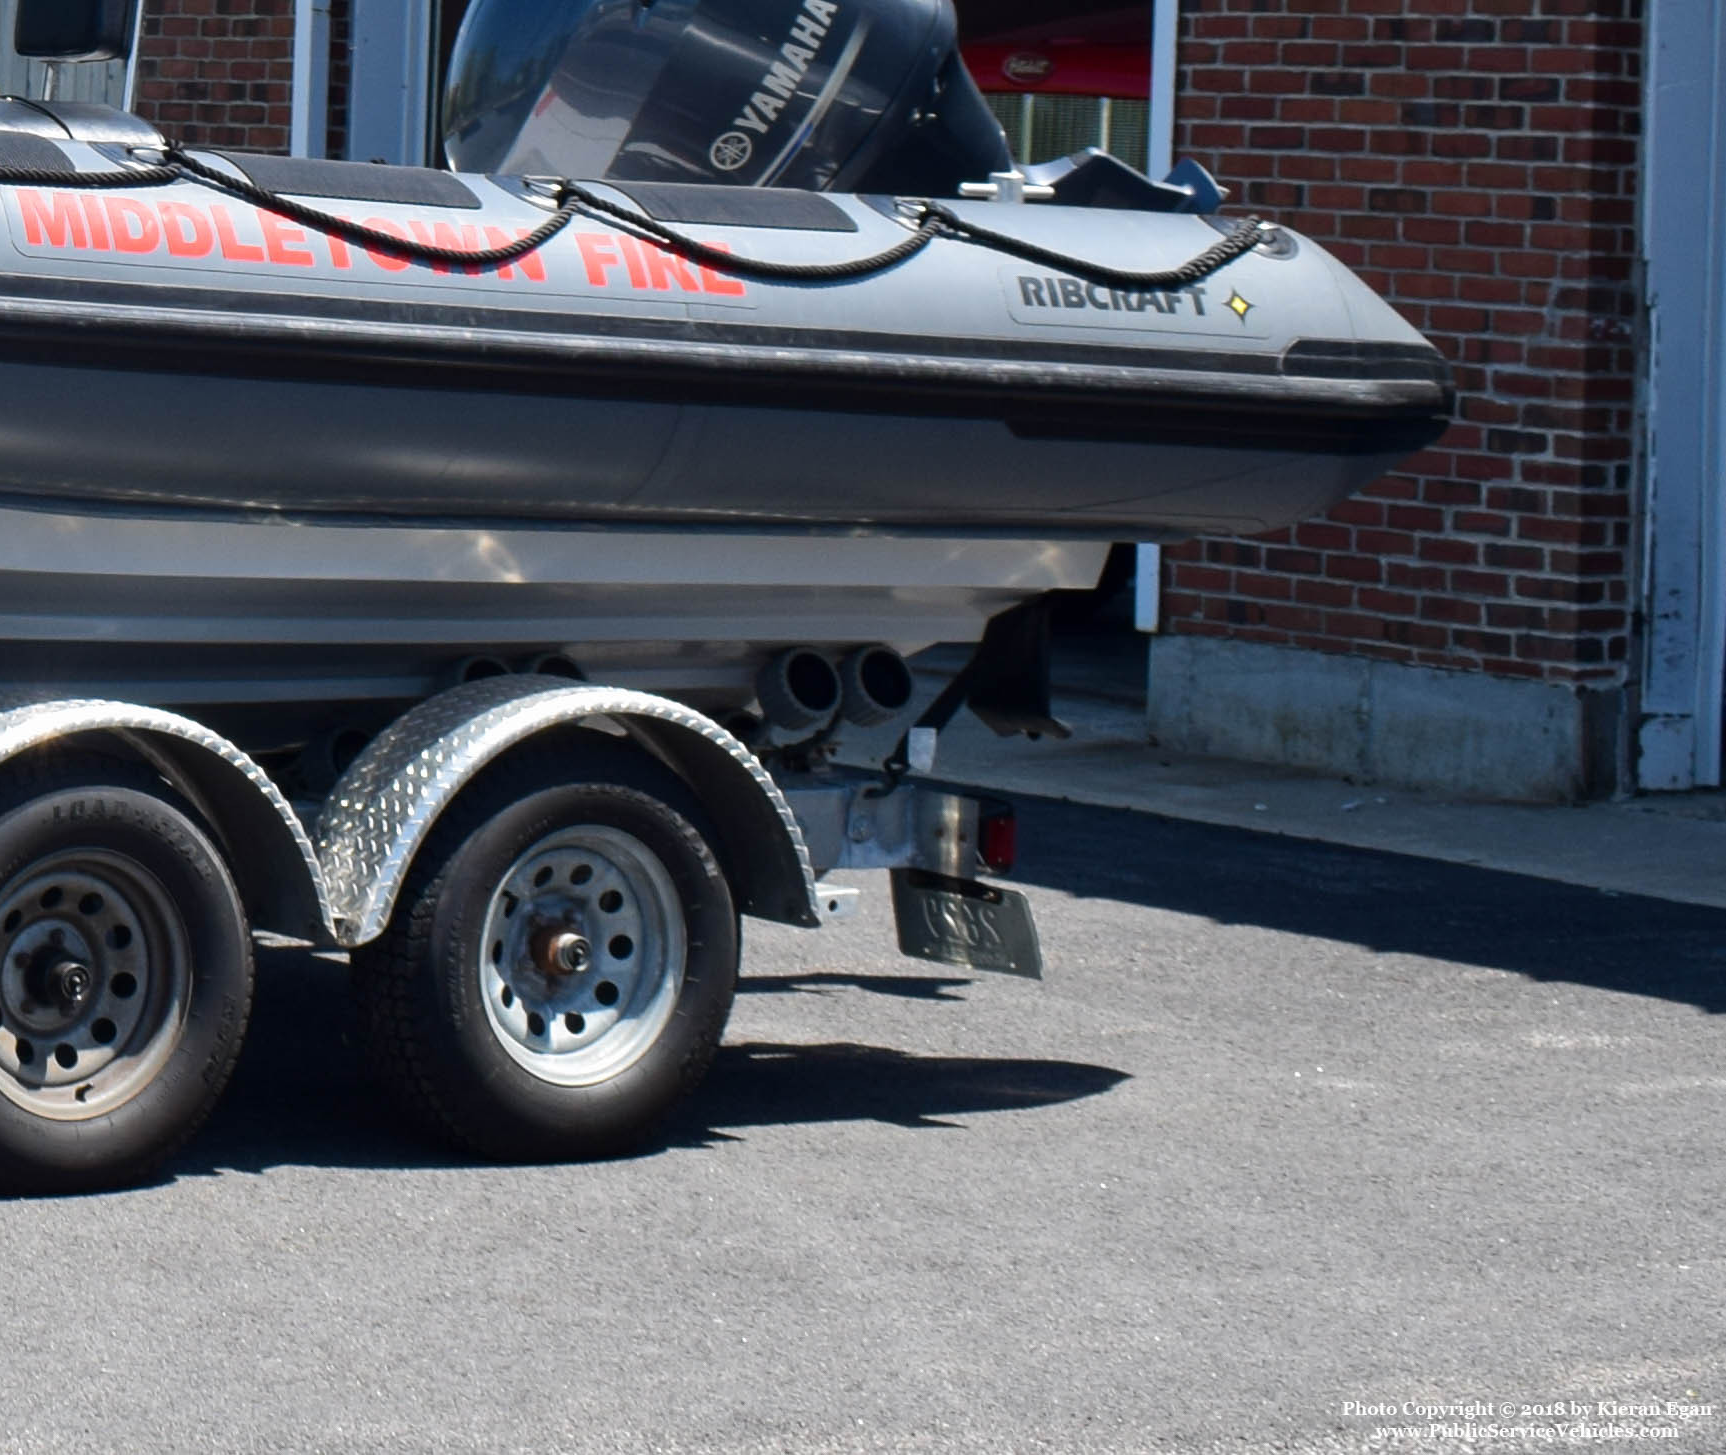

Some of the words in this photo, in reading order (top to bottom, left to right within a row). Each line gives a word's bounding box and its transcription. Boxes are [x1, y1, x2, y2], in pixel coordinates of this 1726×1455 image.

[15, 189, 547, 282] MIDDLETOWN
[575, 232, 747, 296] FIRE
[1017, 276, 1206, 316] RIBCRAFT
